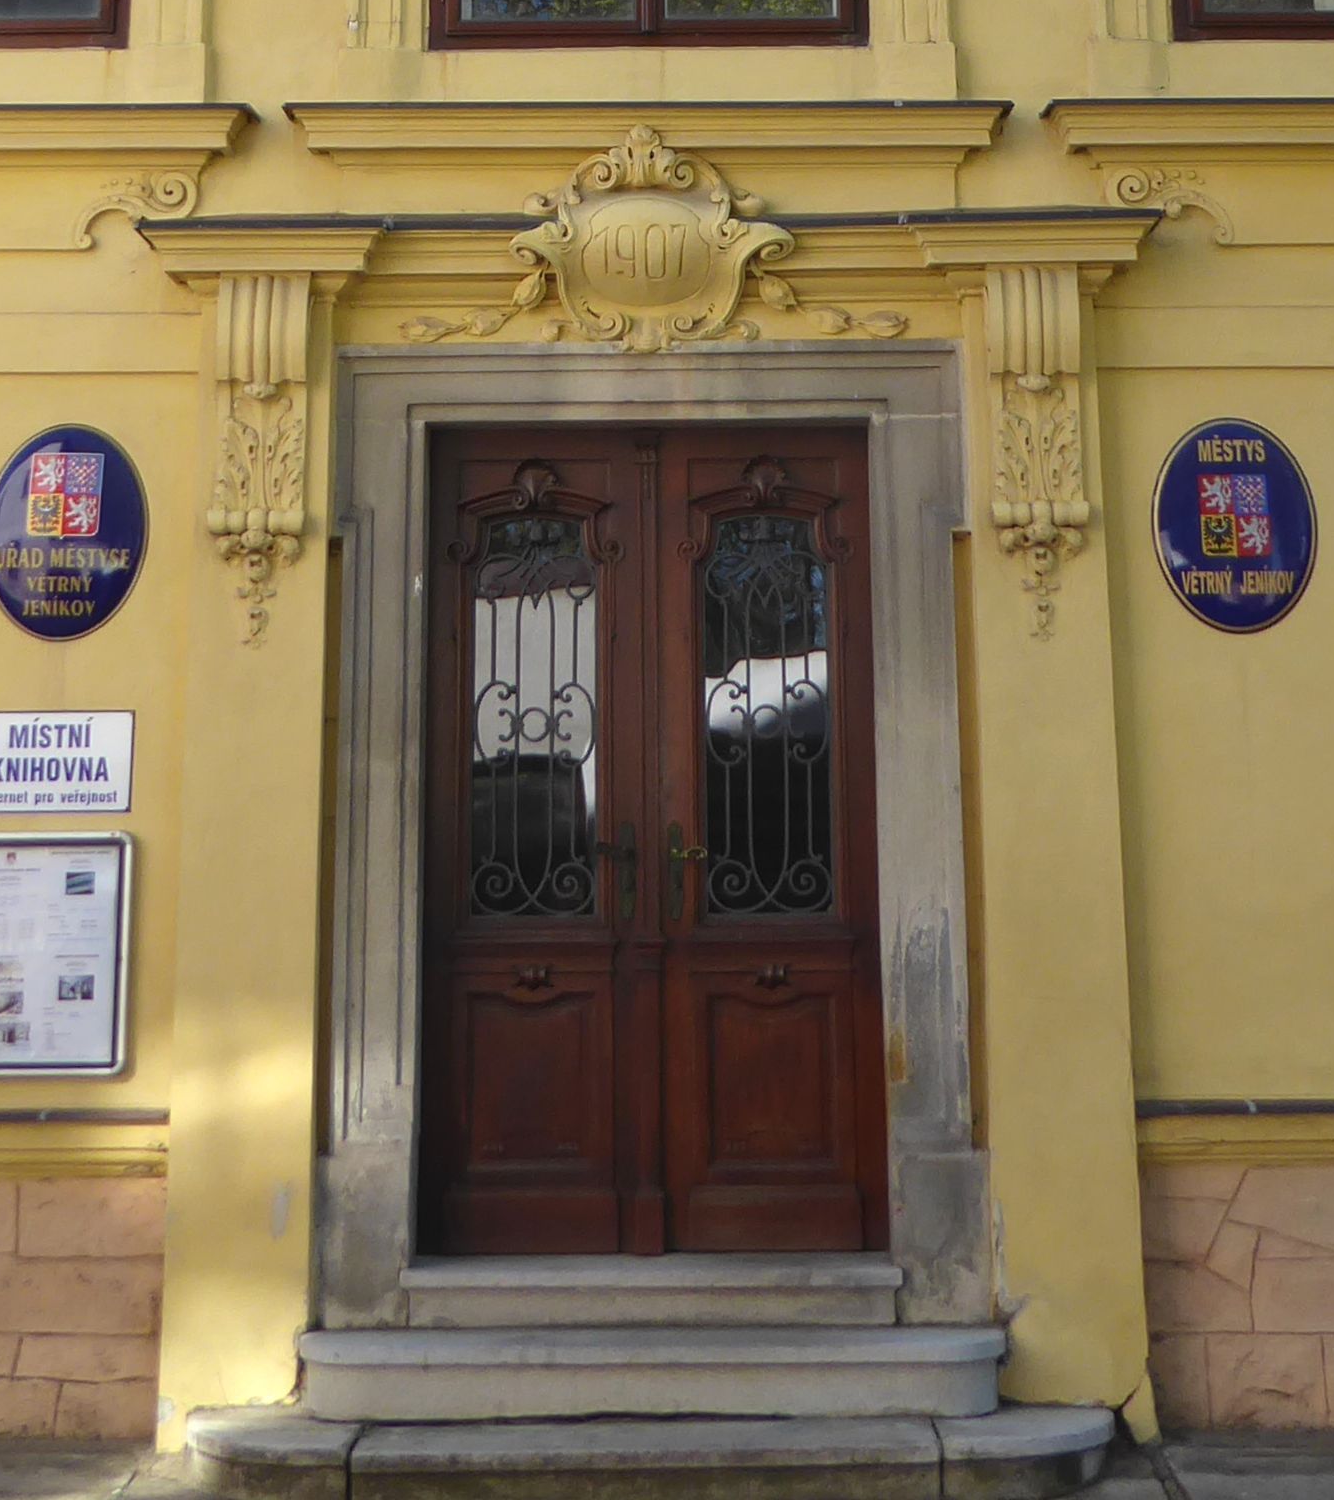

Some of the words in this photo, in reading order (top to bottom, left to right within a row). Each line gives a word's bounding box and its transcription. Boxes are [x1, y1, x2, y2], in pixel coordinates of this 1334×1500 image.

[595, 223, 687, 279] 1907
[1198, 435, 1265, 462] MĚSTYS
[50, 542, 131, 570] MĚSTYSE
[27, 571, 93, 593] VĚTRNÝ
[1181, 565, 1232, 595] VĚTRNÝ
[1240, 565, 1295, 595] JENÍKOV
[22, 595, 96, 617] JENÍKOV
[9, 716, 94, 749] MÍSTNÍ
[34, 792, 55, 806] pro
[60, 789, 118, 806] veřejnost
